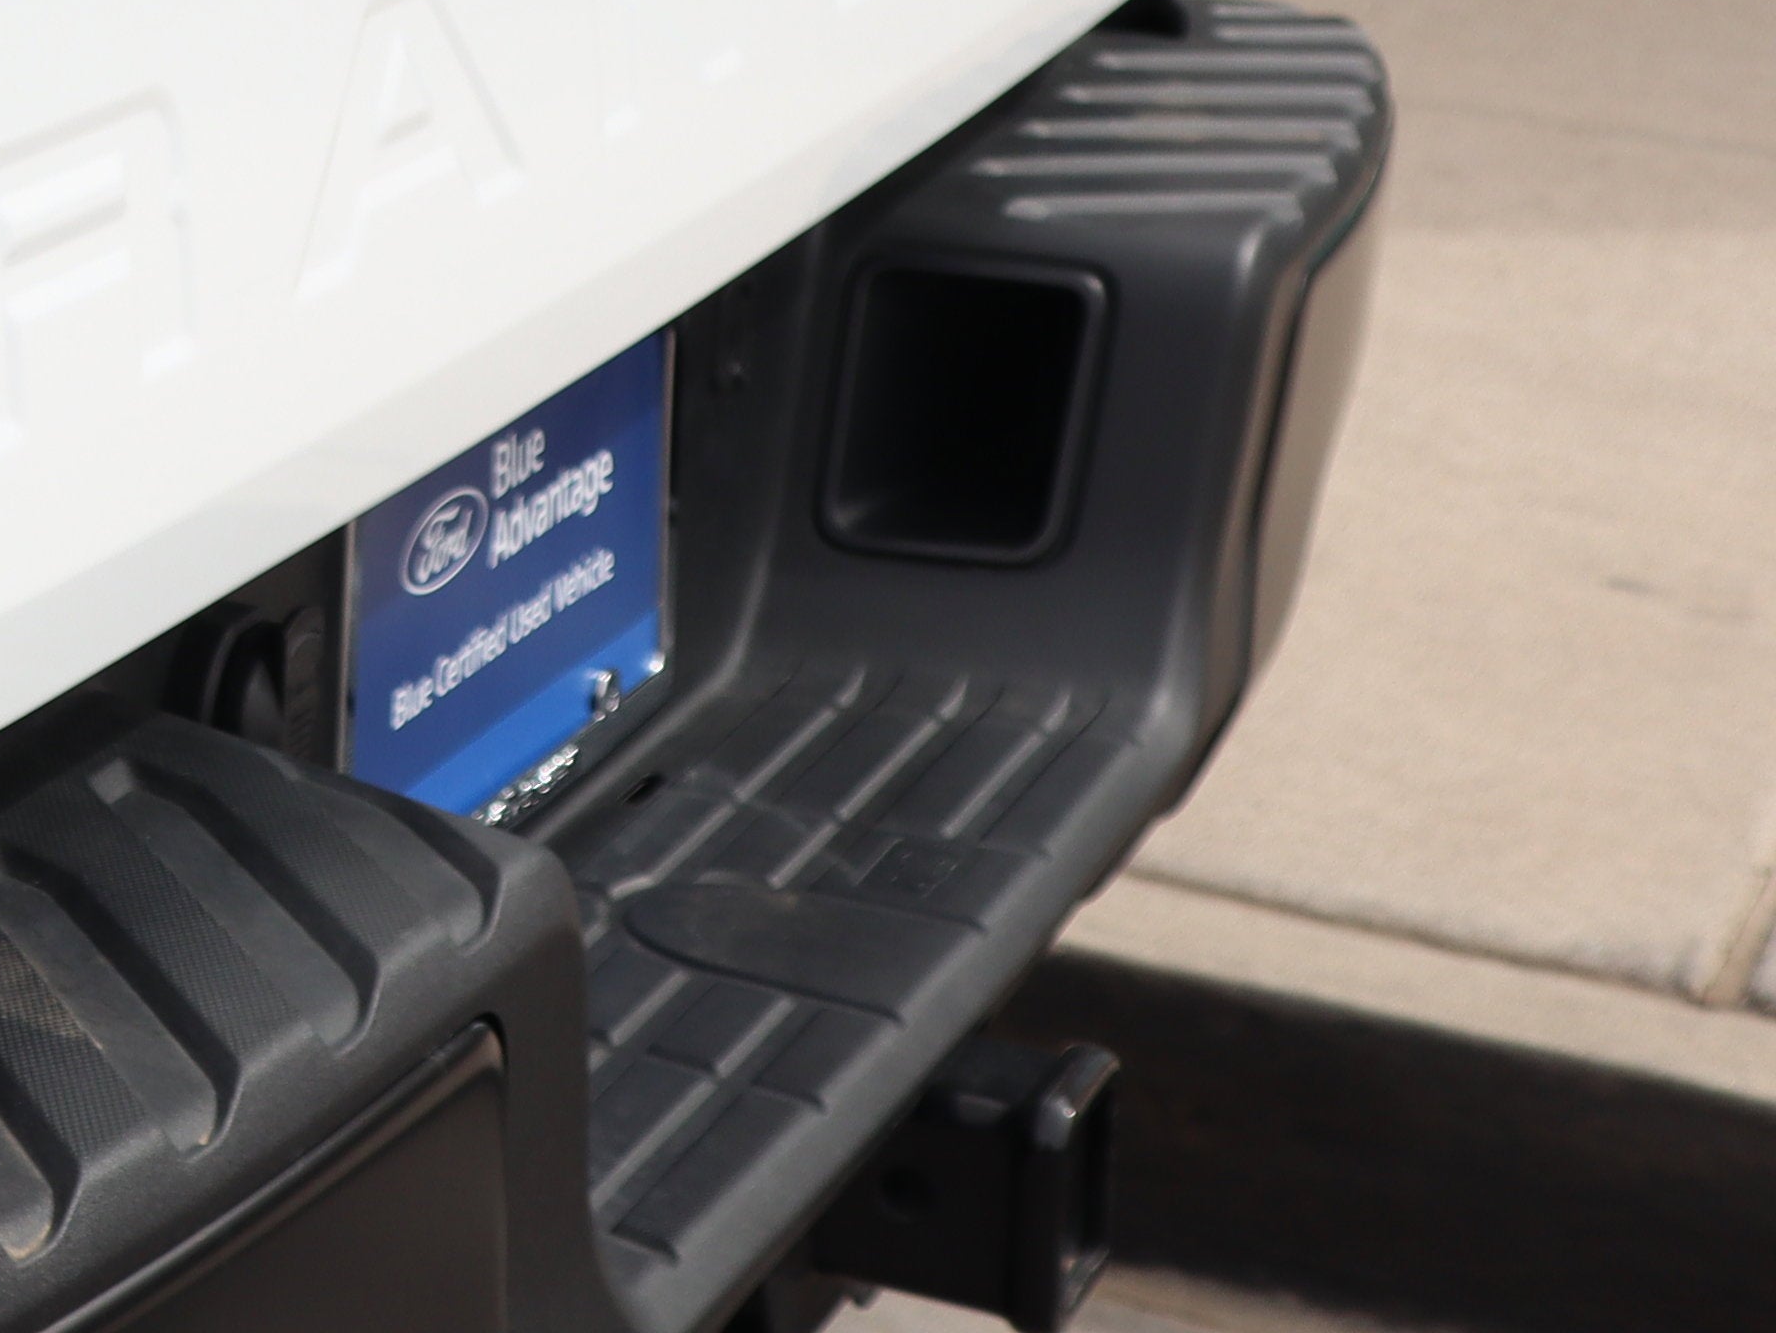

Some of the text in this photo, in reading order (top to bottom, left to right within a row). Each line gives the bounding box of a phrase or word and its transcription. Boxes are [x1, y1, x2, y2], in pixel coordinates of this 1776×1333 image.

[486, 448, 615, 570] Advantage
[491, 427, 546, 501] Blue
[390, 548, 616, 730] Blue Certified Used Vehicle
